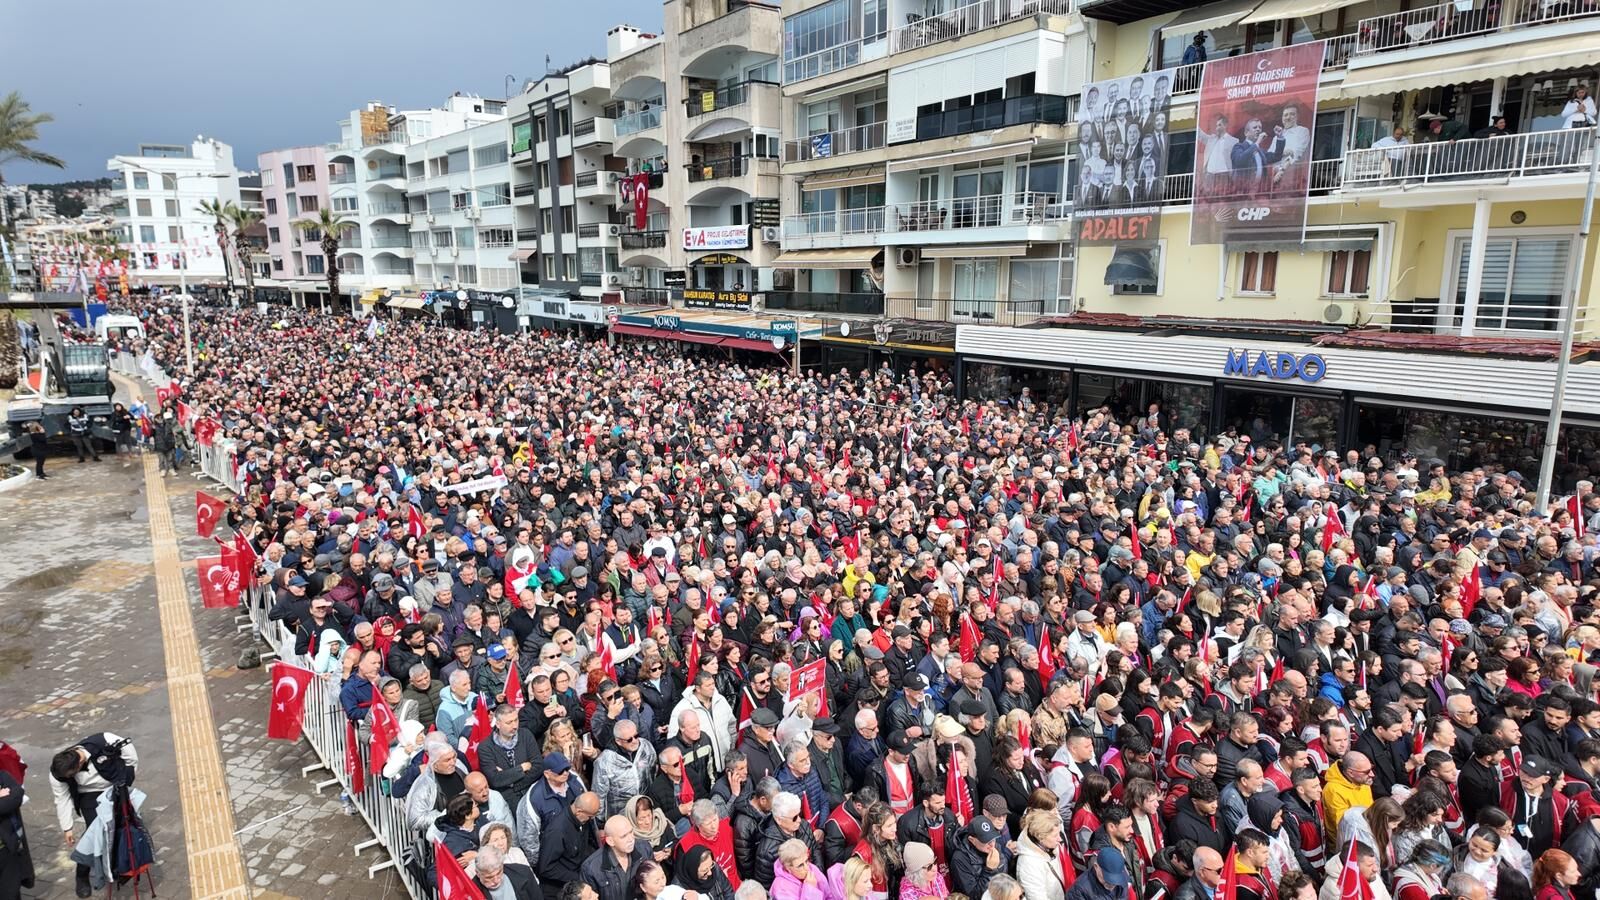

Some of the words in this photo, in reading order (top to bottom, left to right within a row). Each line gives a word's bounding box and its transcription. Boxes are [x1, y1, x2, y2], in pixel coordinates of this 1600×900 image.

[1238, 207, 1270, 221] CHP
[1081, 216, 1152, 240] ADALET
[1224, 347, 1326, 382] MADO
